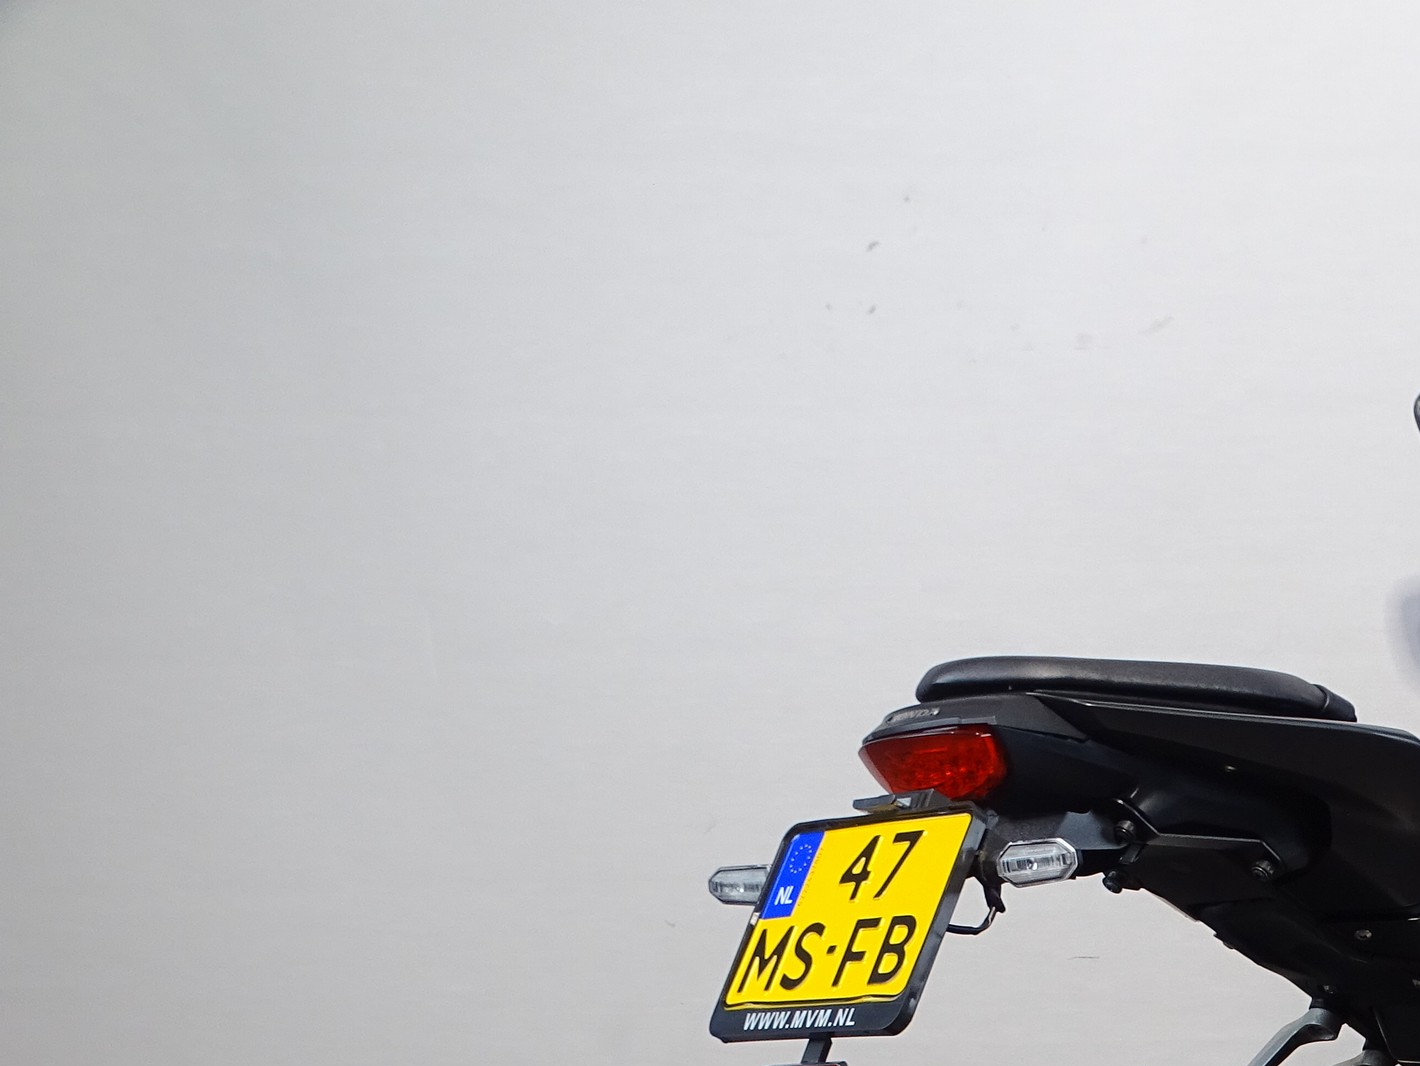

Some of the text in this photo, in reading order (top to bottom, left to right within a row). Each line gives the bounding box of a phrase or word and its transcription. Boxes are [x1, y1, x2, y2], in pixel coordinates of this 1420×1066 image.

[839, 830, 924, 901] 47
[774, 886, 793, 905] NL
[743, 1008, 856, 1031] WWW.MVM.NL
